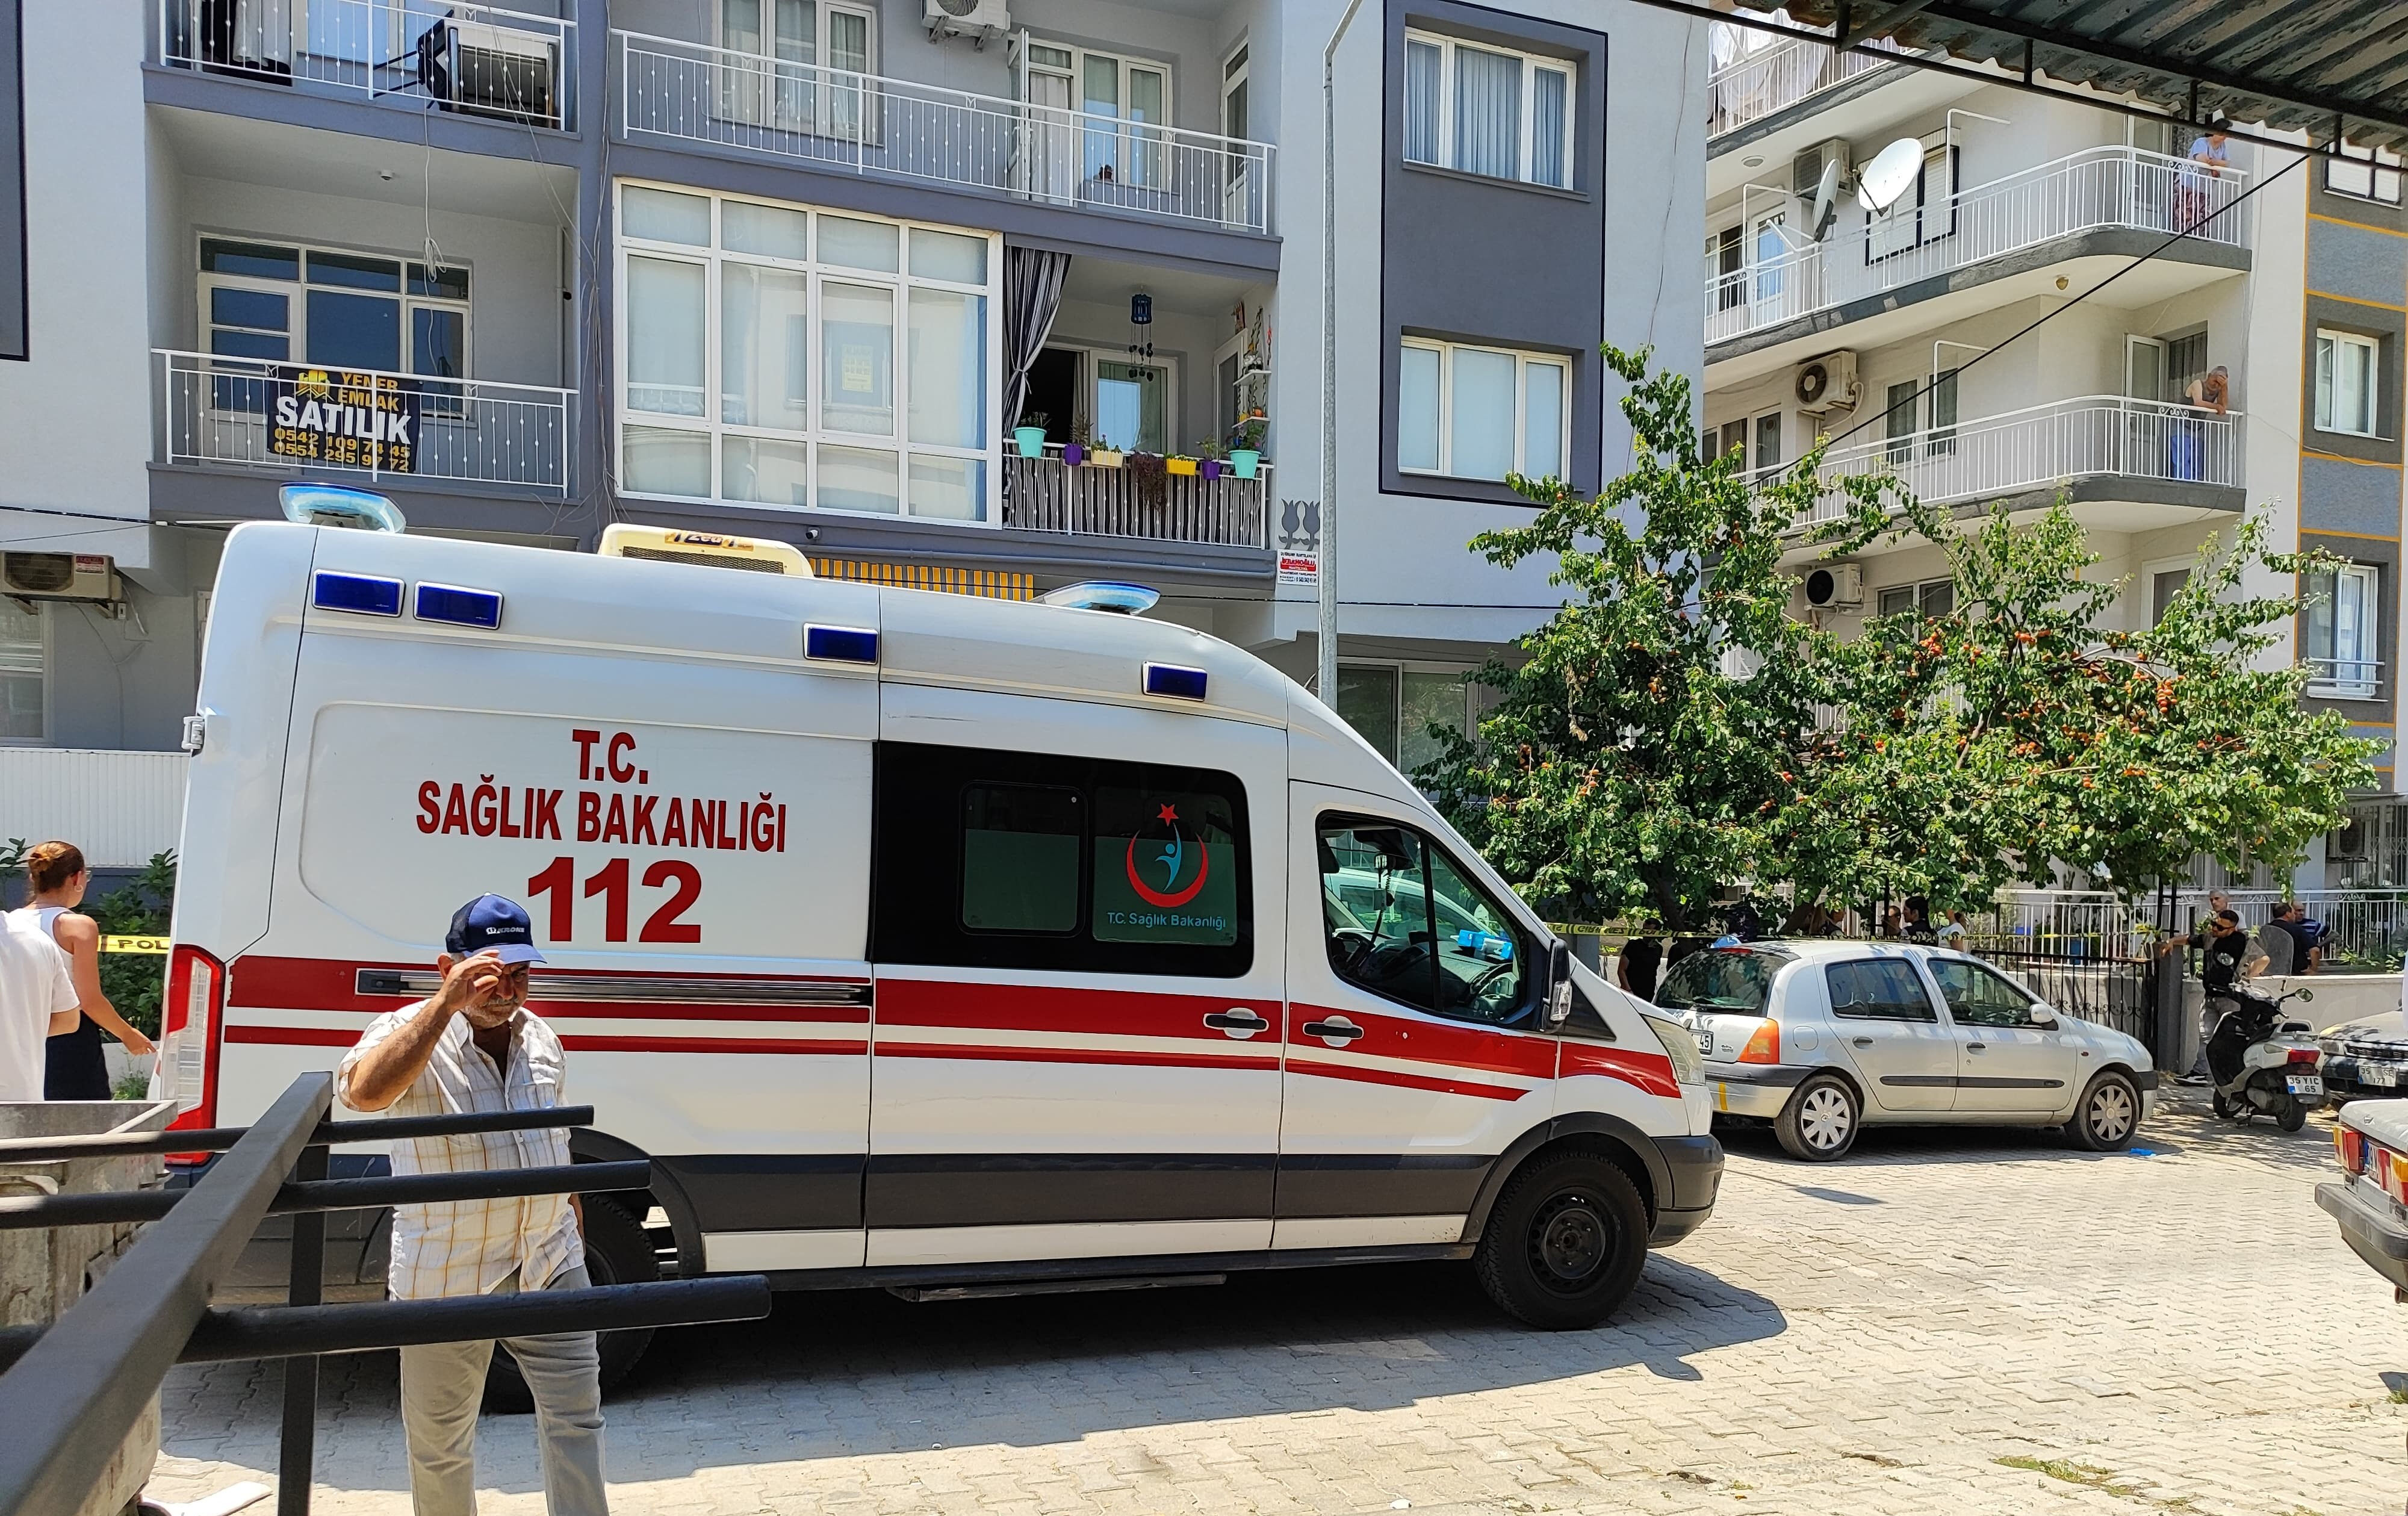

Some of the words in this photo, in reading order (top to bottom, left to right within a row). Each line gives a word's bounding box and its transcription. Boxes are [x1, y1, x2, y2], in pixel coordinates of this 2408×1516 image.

[341, 372, 398, 393] YENER
[338, 388, 400, 411] EMLAK
[276, 396, 412, 444] SATILIK
[275, 428, 318, 445] 0542
[326, 435, 356, 450] 109
[275, 441, 318, 458] 0554
[324, 449, 356, 463] 295
[572, 728, 648, 784] T.C.
[417, 774, 563, 840] SAĞLIK
[577, 791, 787, 853] BAKANLIĞI
[528, 856, 703, 943] 112
[1107, 912, 1126, 925] T.C.
[1129, 912, 1167, 928] Sağlık
[1171, 915, 1226, 931] Bakanlığı
[117, 939, 169, 950] POL
[1699, 1034, 1709, 1048] 45
